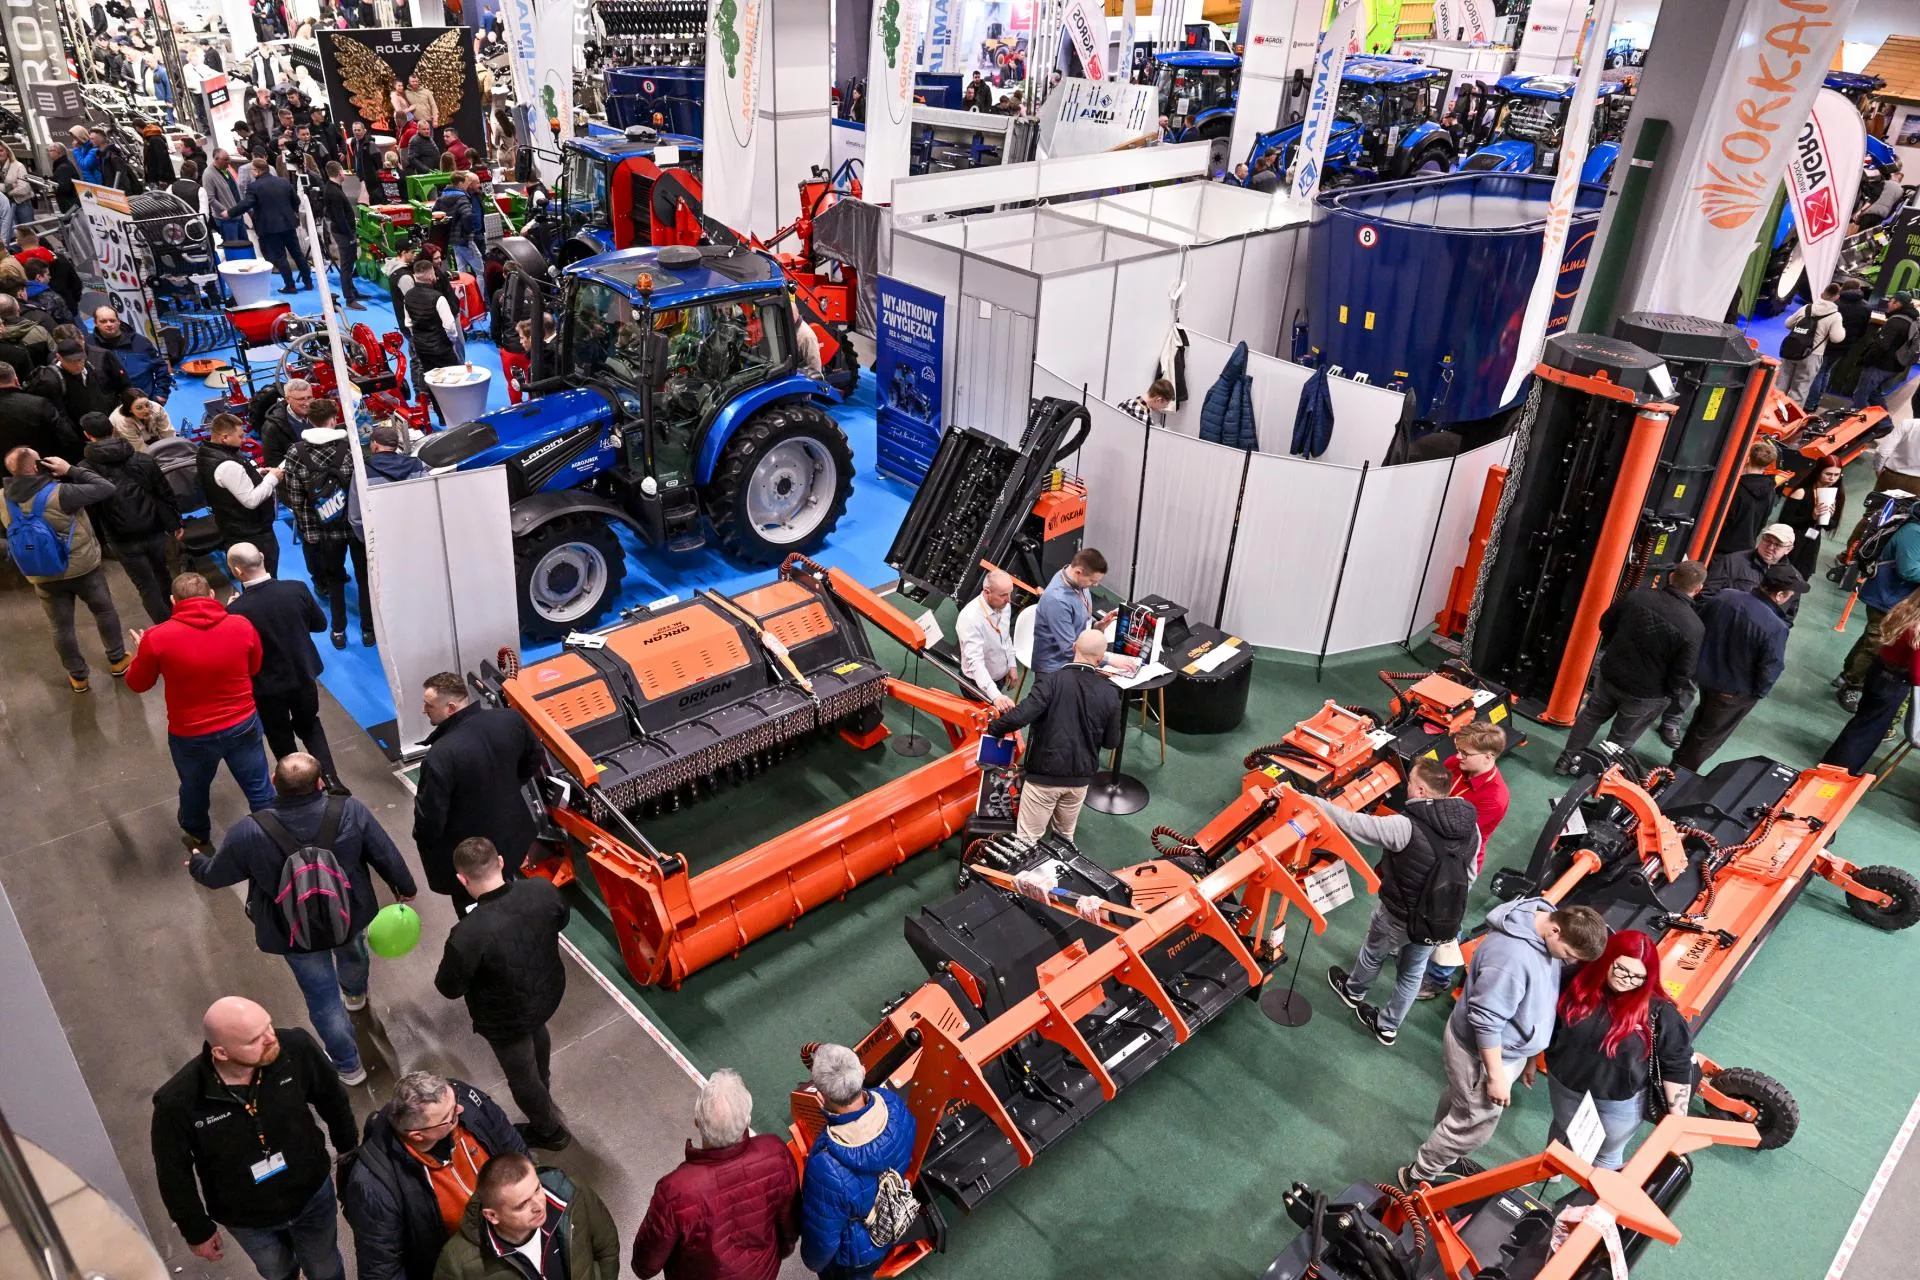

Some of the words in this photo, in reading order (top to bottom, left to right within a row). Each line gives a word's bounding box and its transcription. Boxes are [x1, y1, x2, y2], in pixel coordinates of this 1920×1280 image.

[38, 2, 61, 76] UALITY
[375, 44, 421, 53] ROLEX
[742, 4, 756, 121] AGROJUREK
[1305, 48, 1335, 152] ALIMA
[1363, 230, 1371, 242] 8
[882, 292, 938, 327] WYJĄTKOWY
[882, 309, 936, 343] ZWYCIĘZCA.
[571, 456, 599, 469] AGROJUREK
[318, 490, 346, 521] NIKE
[643, 626, 690, 646] ORKAN
[678, 680, 732, 707] ORKAN
